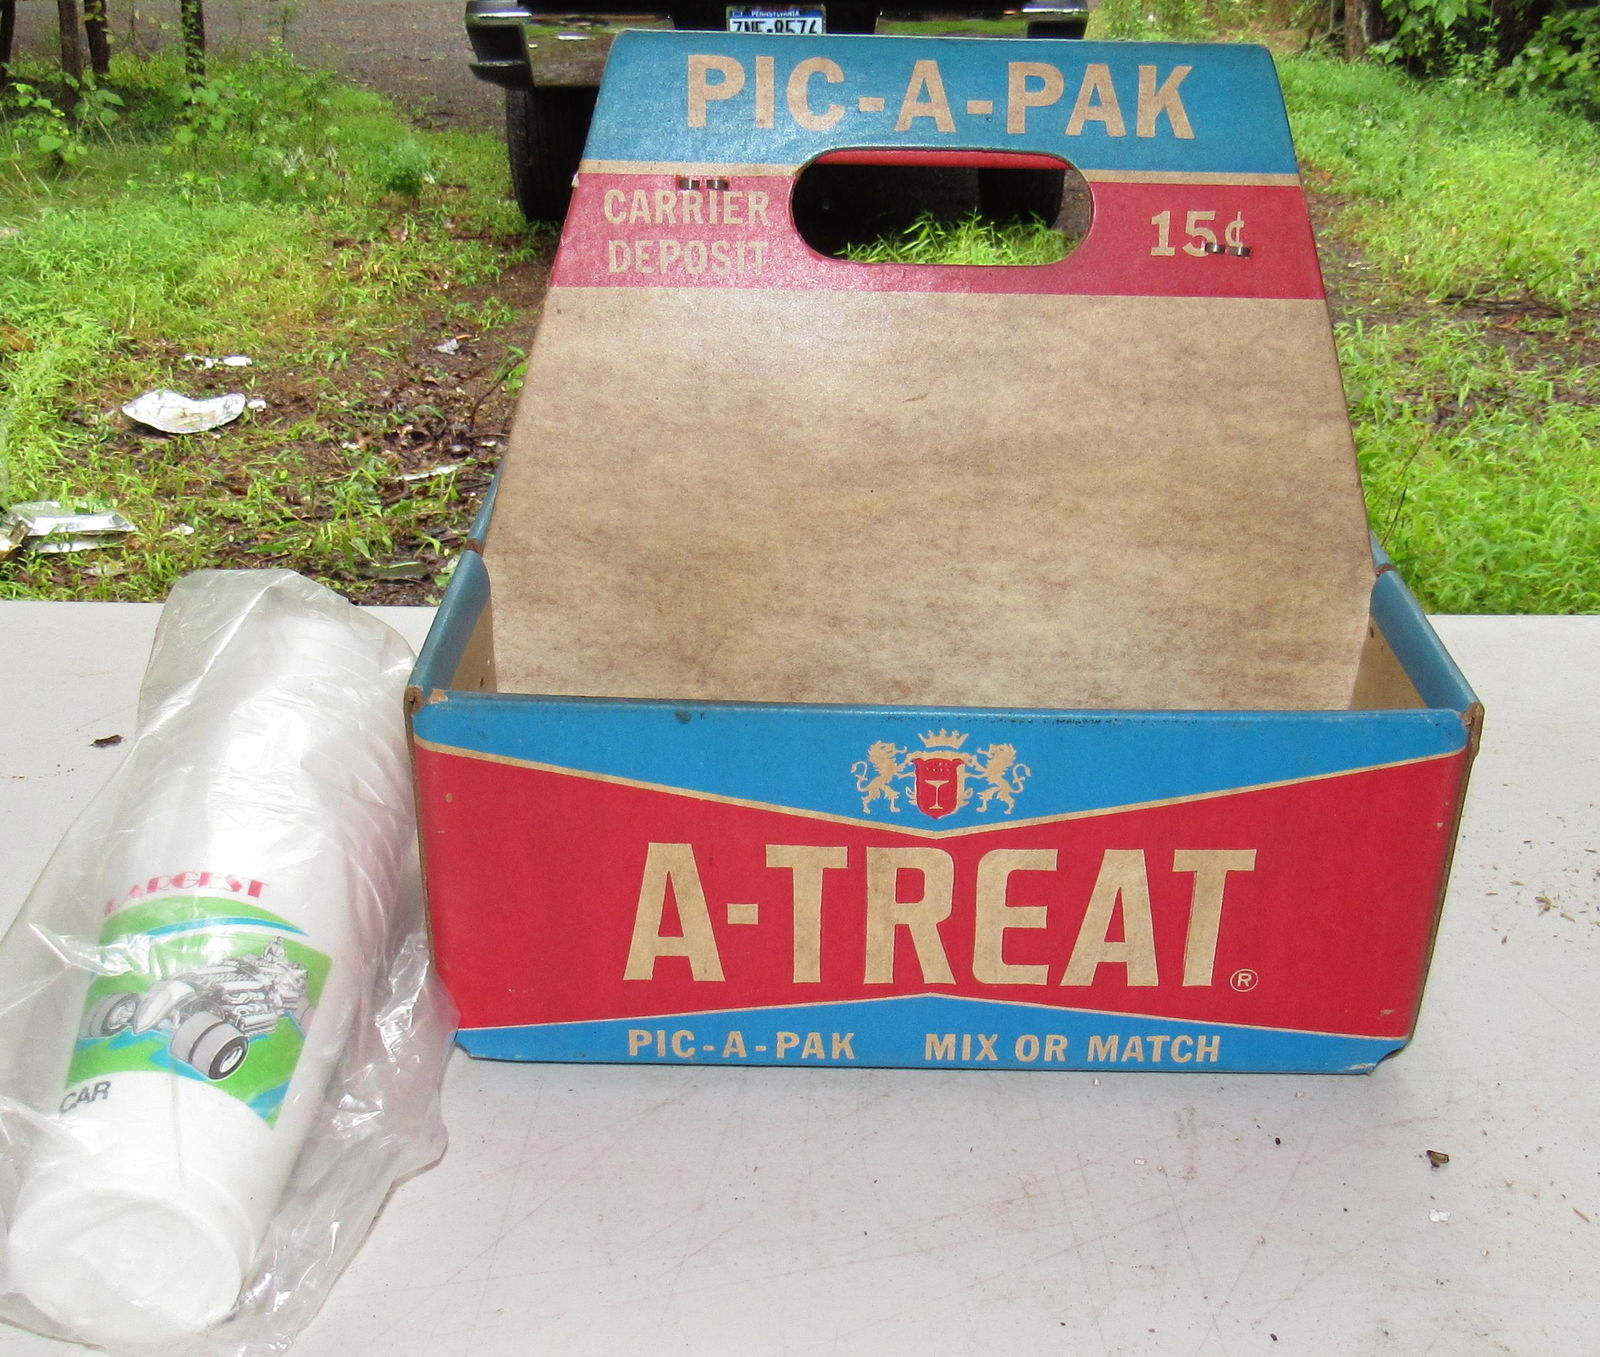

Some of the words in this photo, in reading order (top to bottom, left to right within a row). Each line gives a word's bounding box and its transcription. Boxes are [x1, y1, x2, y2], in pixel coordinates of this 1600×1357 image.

[751, 9, 800, 17] PENNSYLVANIA
[687, 54, 1196, 140] PIC-A-PAK
[603, 189, 770, 226] CARRIER
[1150, 210, 1246, 258] 15¢
[607, 239, 769, 275] DEPOSIT
[104, 871, 270, 916] LARGEST
[622, 842, 1257, 987] A-TREAT
[627, 1028, 856, 1061] PIC-A-PAK
[924, 1033, 998, 1062] MIX
[1014, 1034, 1069, 1062] OR
[1086, 1034, 1221, 1063] MATCH
[59, 1080, 111, 1115] CAR
